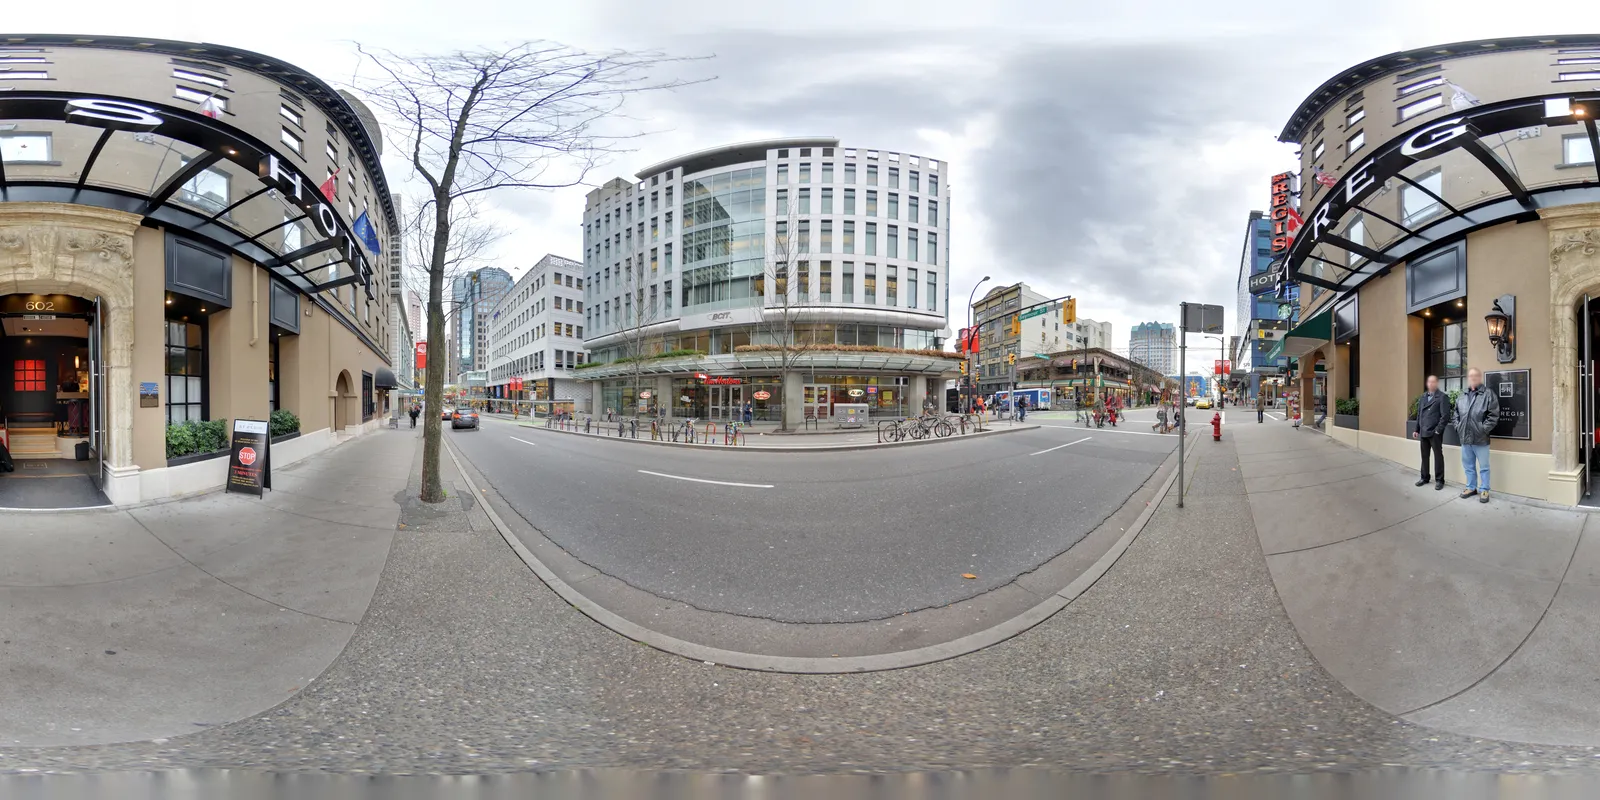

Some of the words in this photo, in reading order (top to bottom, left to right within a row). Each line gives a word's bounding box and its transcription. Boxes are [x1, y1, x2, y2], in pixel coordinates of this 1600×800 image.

[1271, 183, 1290, 252] REGIS
[25, 301, 55, 311] 602
[711, 311, 731, 321] BCIT
[239, 451, 256, 461] STOP
